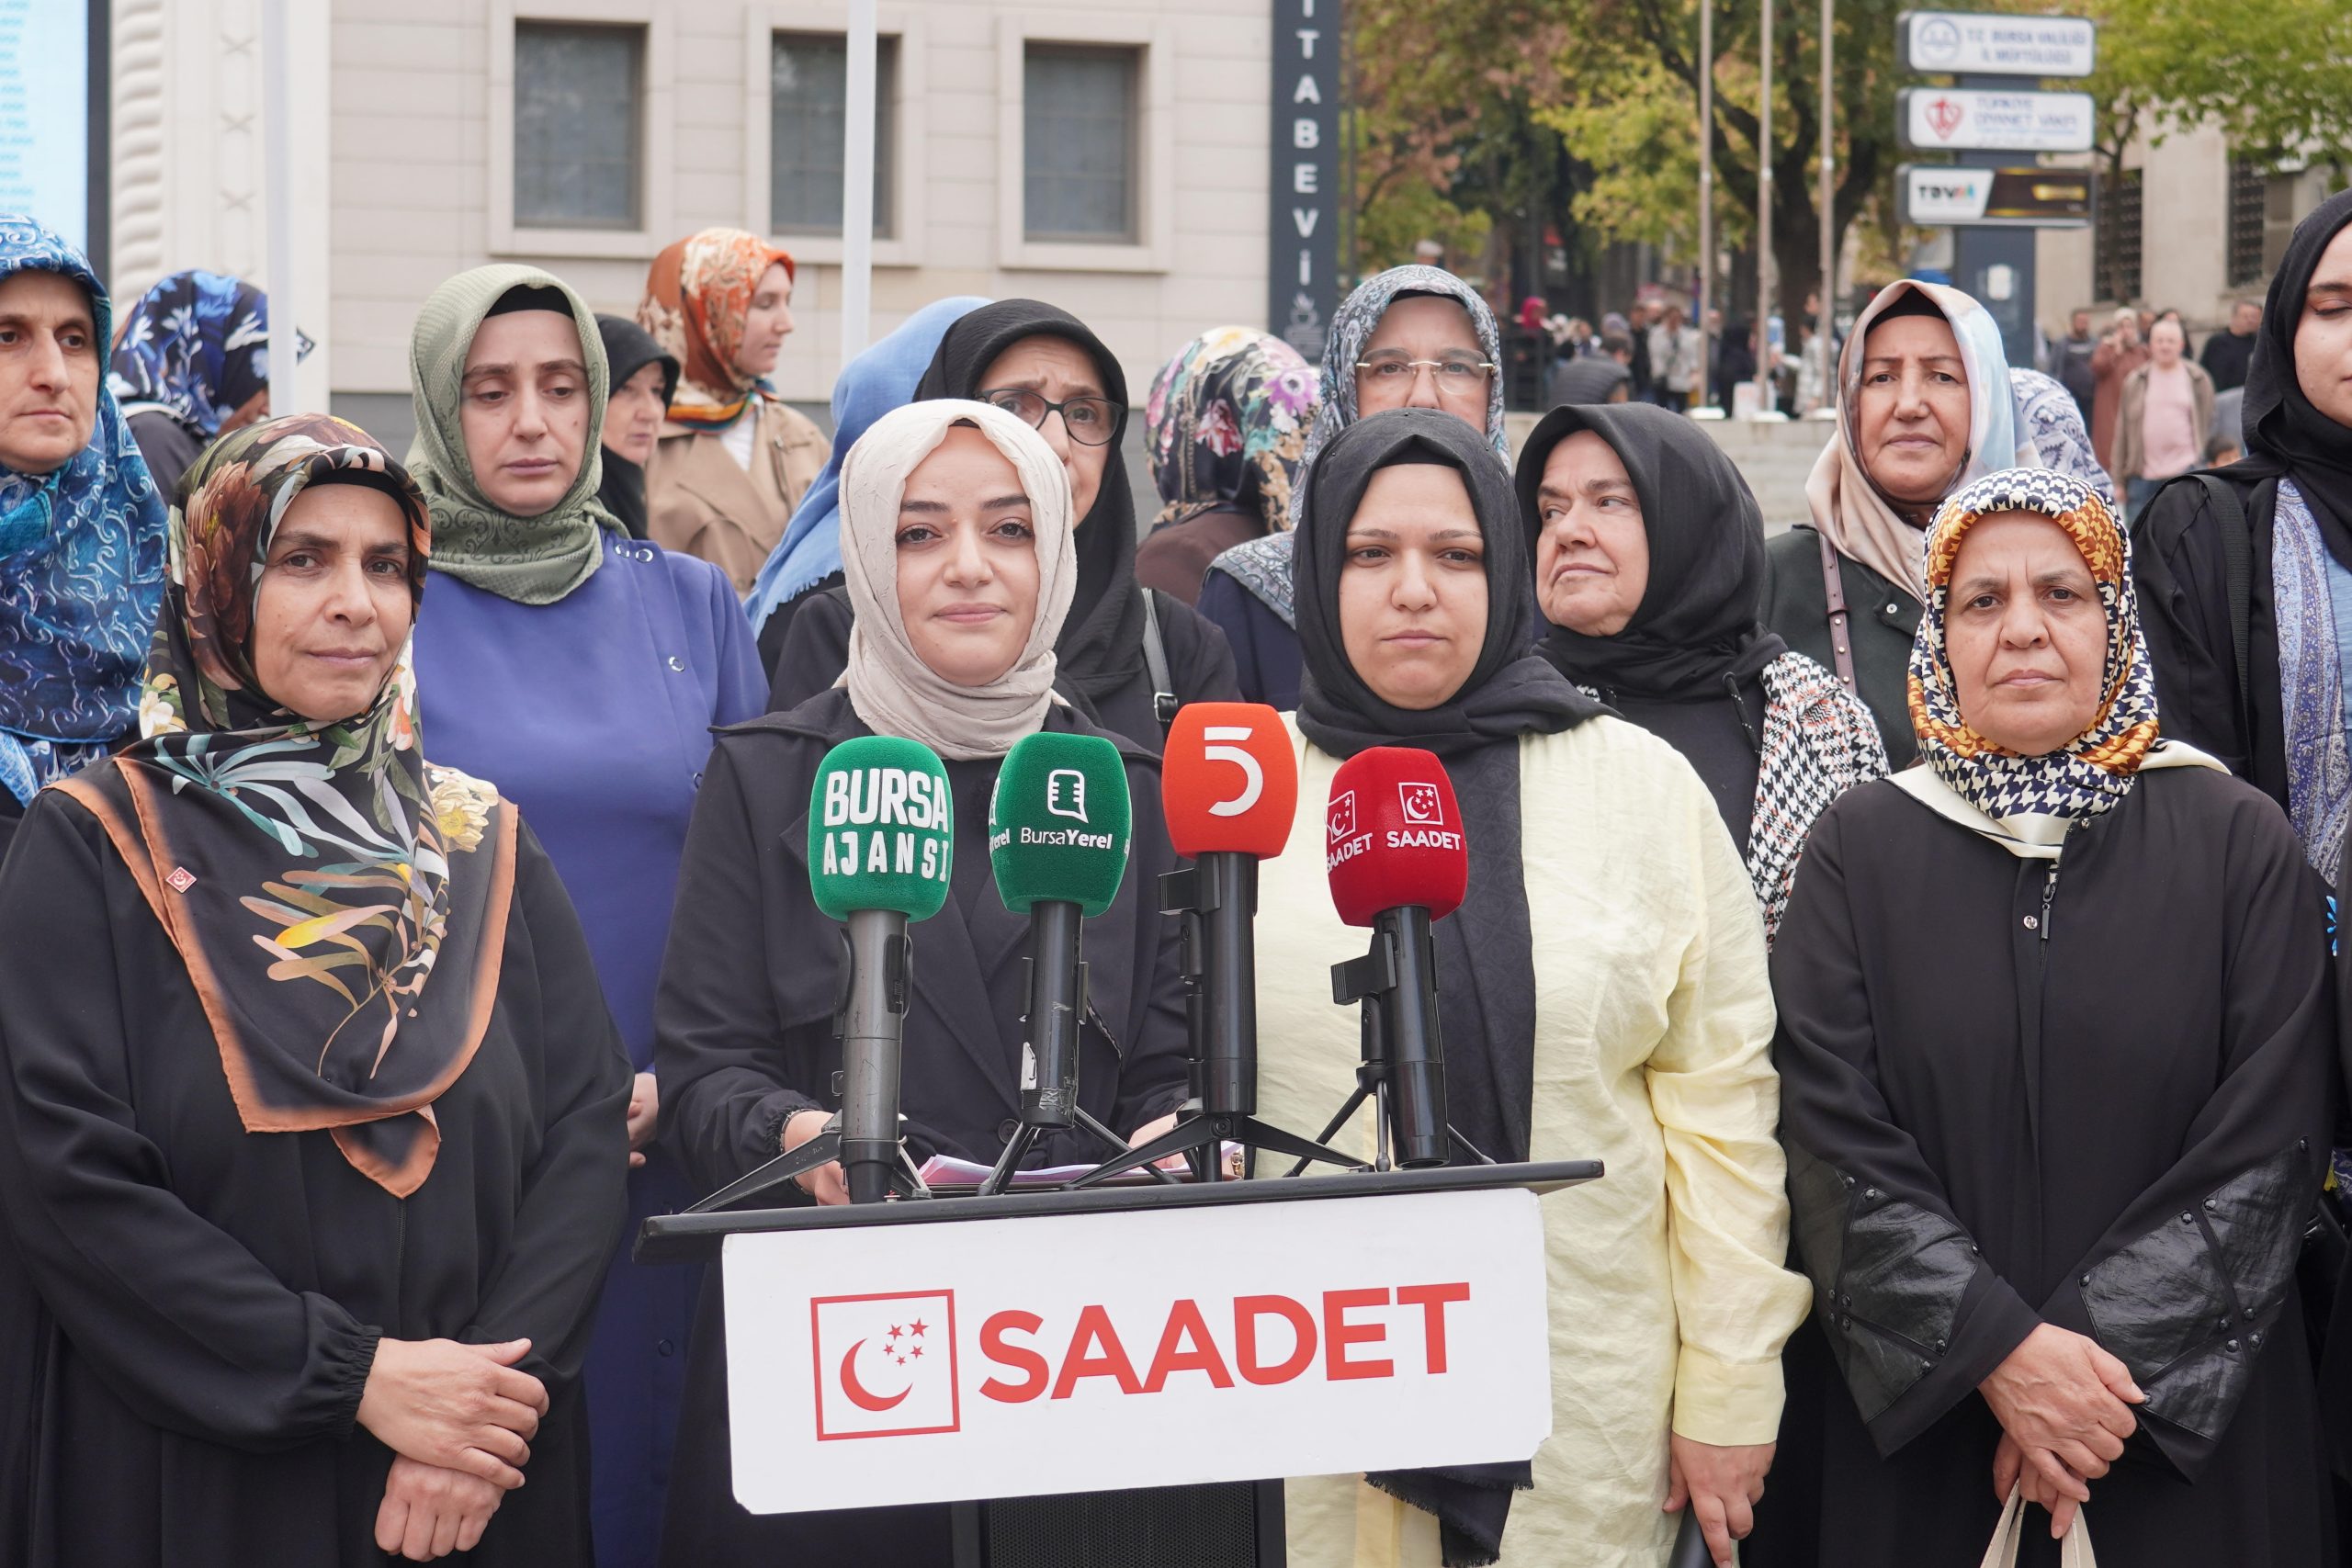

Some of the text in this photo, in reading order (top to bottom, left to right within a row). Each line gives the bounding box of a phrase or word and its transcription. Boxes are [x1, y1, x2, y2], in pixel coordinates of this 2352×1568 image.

[824, 768, 948, 832] BURSA
[1204, 727, 1263, 817] 5
[823, 830, 948, 882] AJANSI
[1021, 828, 1113, 850] BursaYerel
[1386, 830, 1461, 851] SAADET
[978, 1282, 1470, 1404] SAADET
